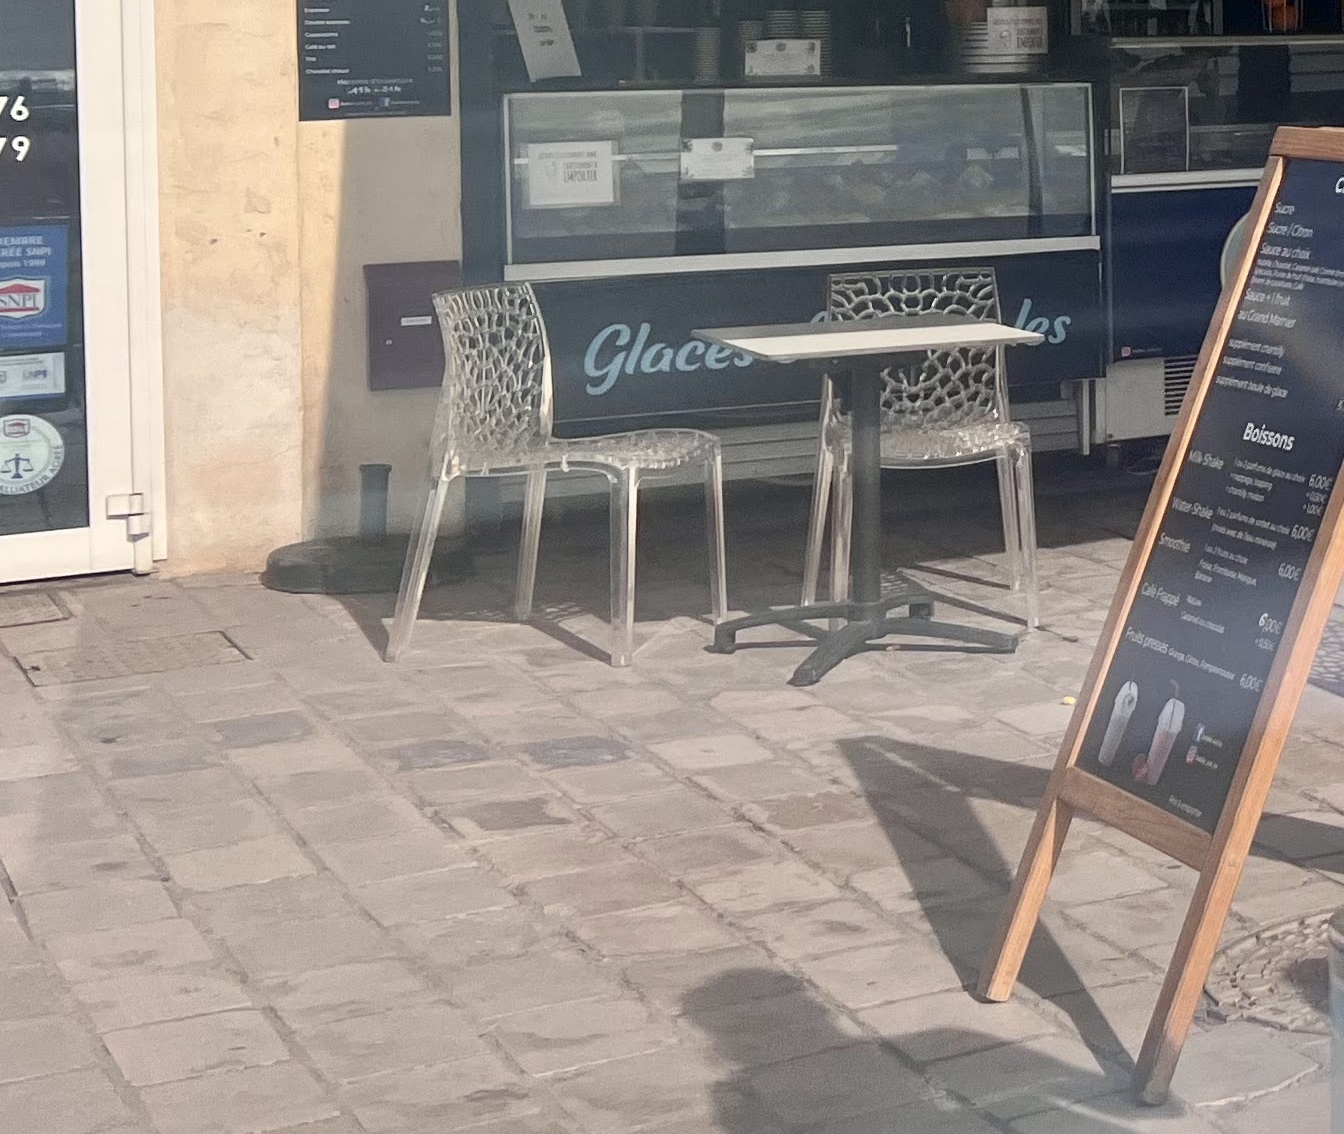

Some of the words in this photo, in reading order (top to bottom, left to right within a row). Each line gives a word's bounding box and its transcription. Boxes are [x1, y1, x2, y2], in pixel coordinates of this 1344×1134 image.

[1273, 201, 1295, 215] Sucre
[1266, 221, 1289, 236] Sucre
[1259, 241, 1282, 256] Sauce
[1243, 287, 1266, 303] Sauce
[1246, 308, 1271, 324] Grand
[1242, 422, 1296, 451] Boissons
[1290, 523, 1315, 542] 6,00€
[1277, 562, 1302, 582] 6,00€
